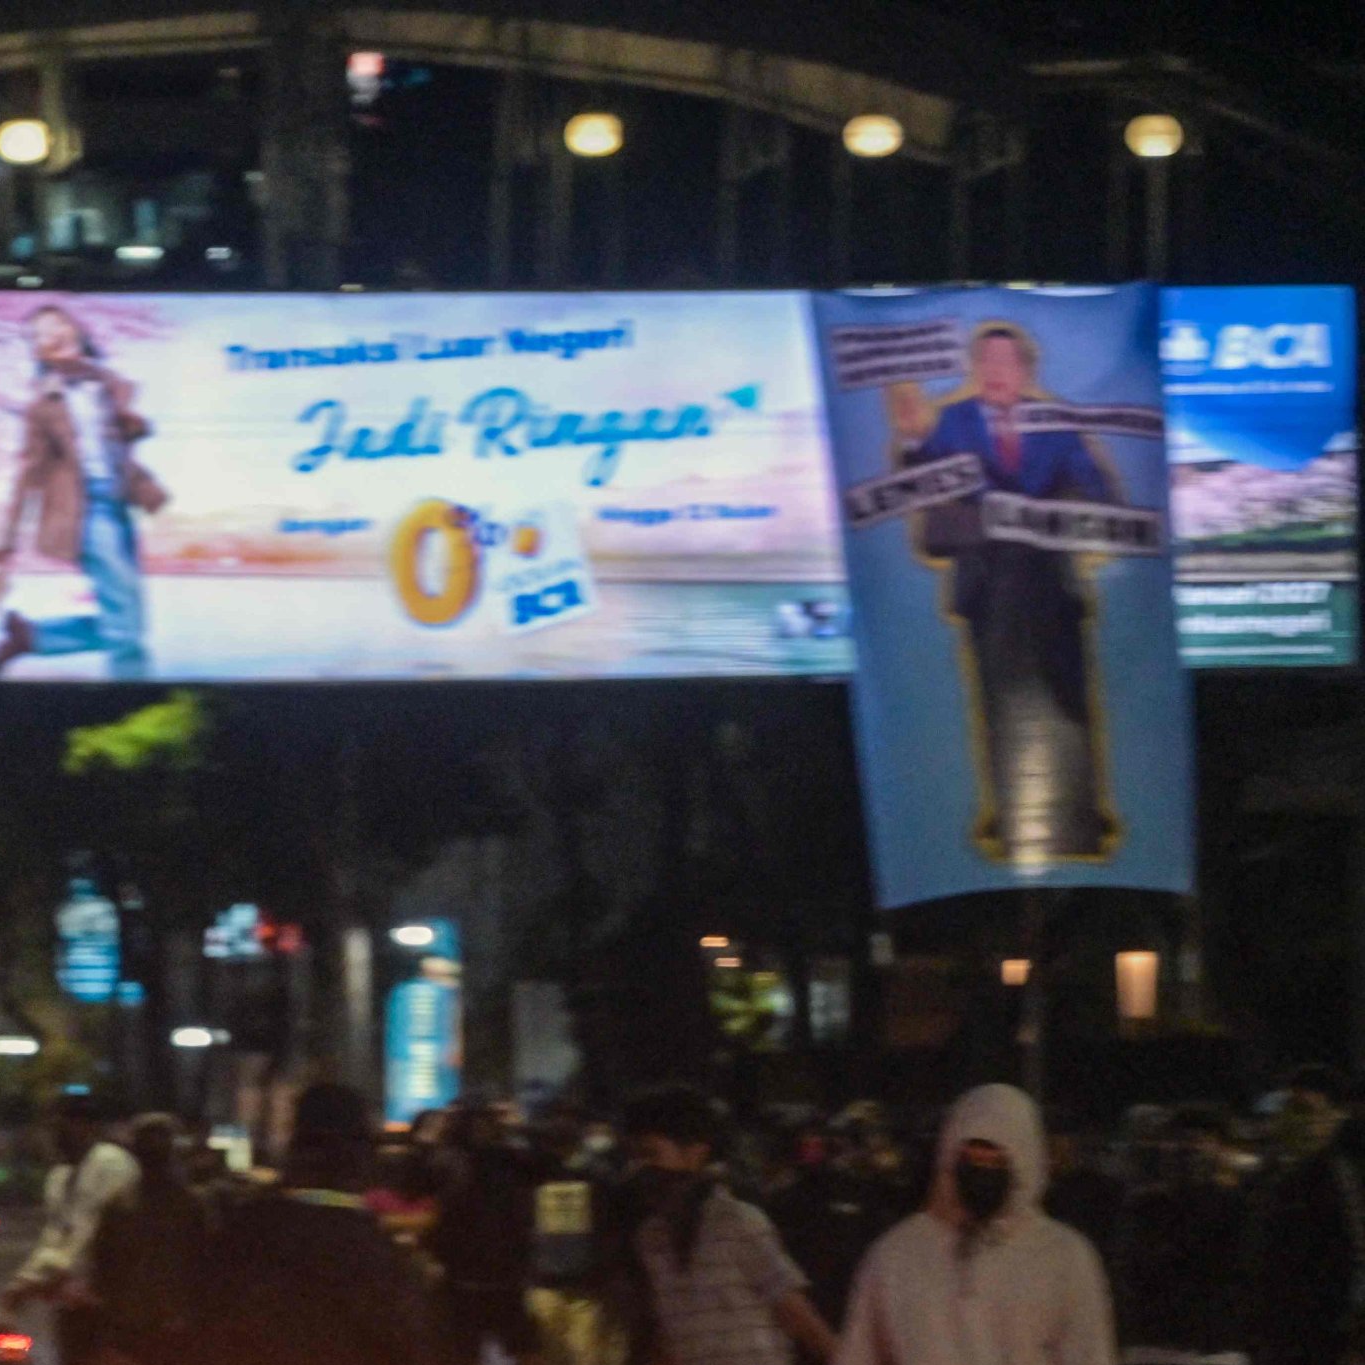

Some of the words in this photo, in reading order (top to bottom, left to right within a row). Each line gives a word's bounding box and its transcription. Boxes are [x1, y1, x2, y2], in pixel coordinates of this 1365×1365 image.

[1211, 323, 1333, 370] BCA
[290, 398, 452, 472] Jadi
[458, 386, 715, 488] Ringan
